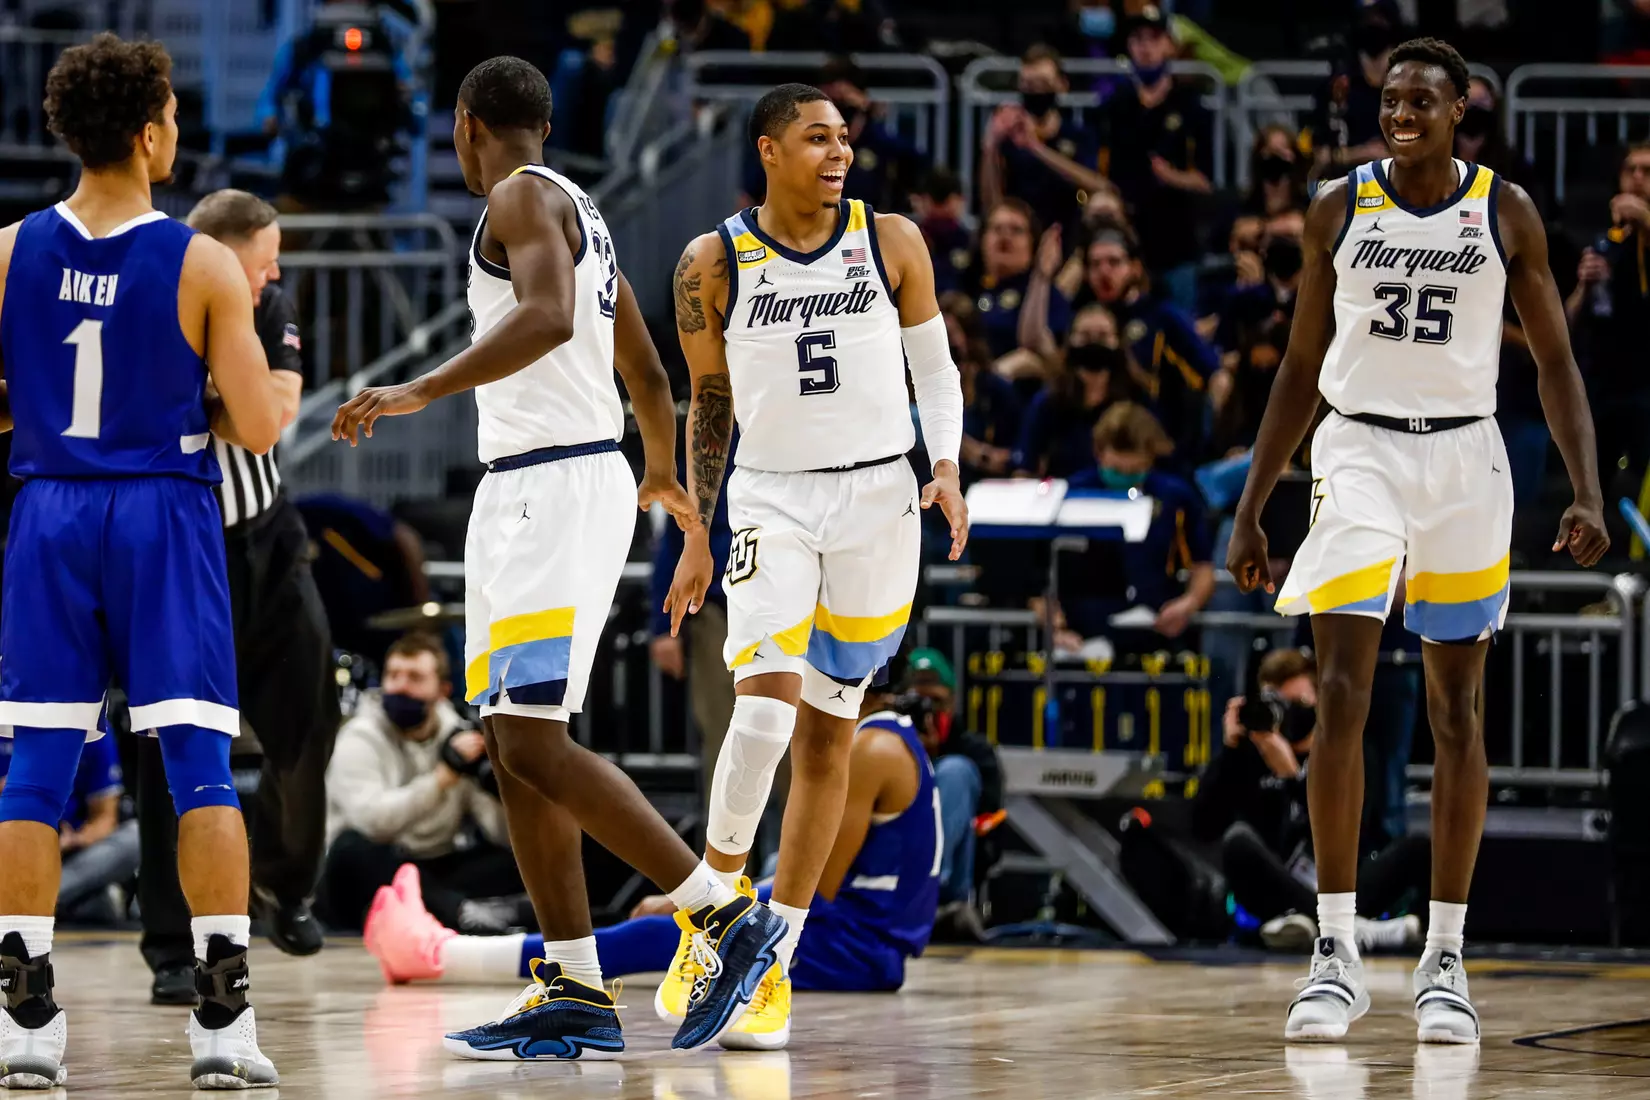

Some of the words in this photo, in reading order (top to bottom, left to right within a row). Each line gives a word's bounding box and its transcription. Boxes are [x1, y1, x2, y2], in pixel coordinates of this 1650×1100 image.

[846, 270, 871, 278] EAST
[1350, 240, 1487, 277] Marquette
[58, 268, 119, 306] AIKEN
[747, 281, 877, 328] Marquette
[1369, 282, 1457, 345] 35
[61, 318, 103, 439] 1
[795, 330, 840, 396] 5
